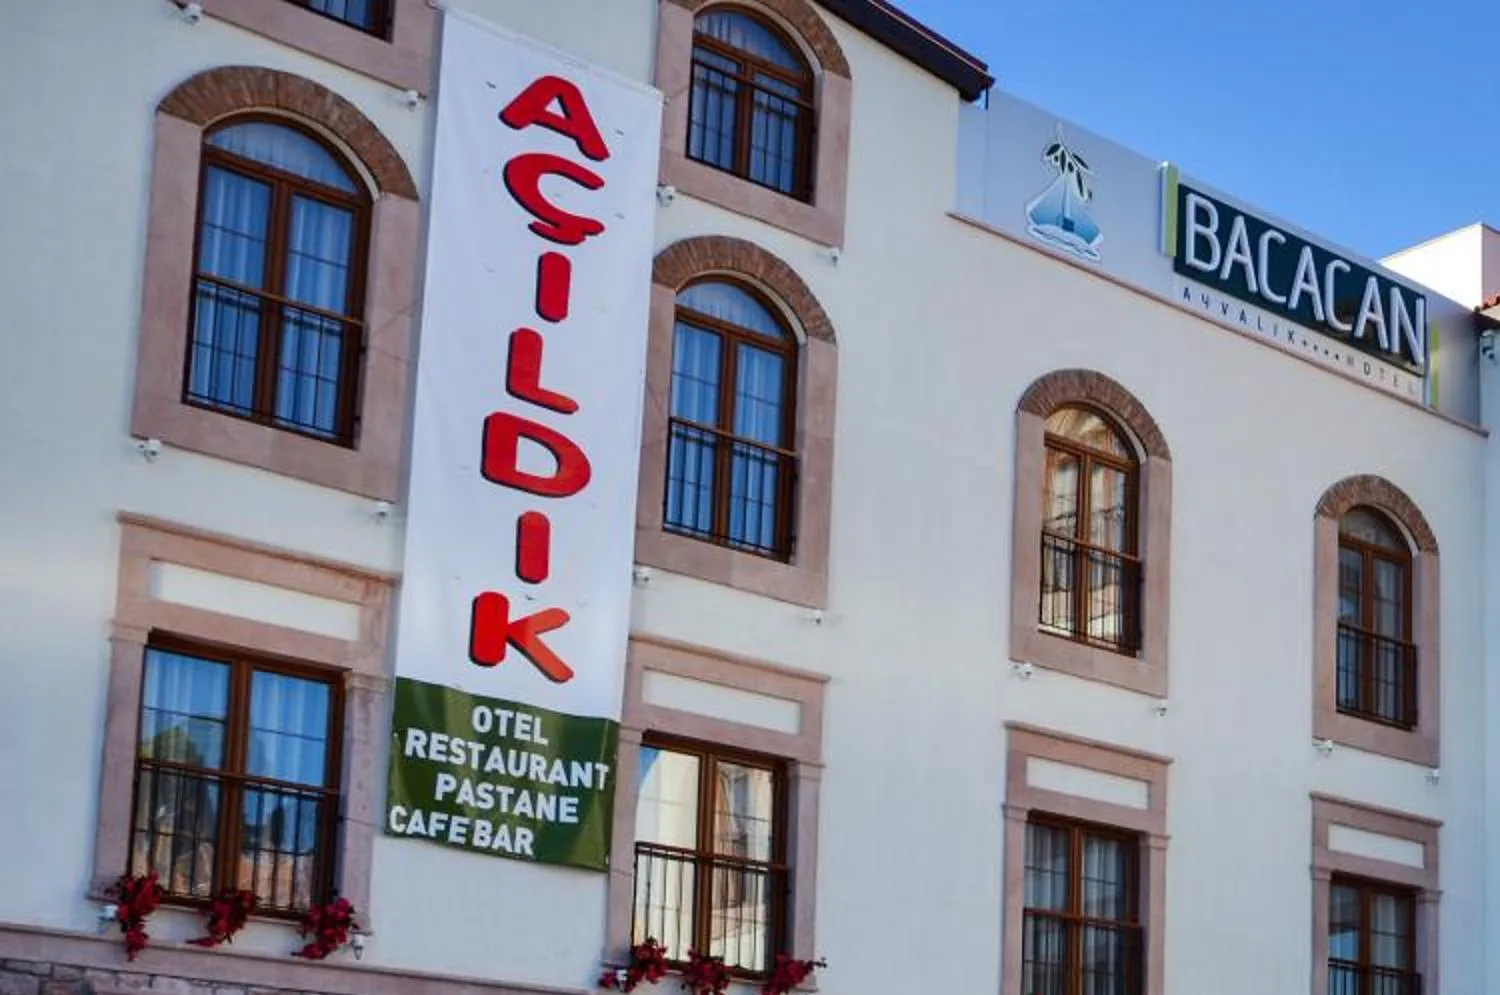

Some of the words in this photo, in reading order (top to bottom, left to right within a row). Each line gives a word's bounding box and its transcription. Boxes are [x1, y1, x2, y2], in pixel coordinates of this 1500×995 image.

[1185, 192, 1426, 367] BACACAN
[469, 75, 611, 684] AÇILDIK
[1346, 355, 1418, 395] HOTEL
[471, 705, 549, 746] OTEL
[405, 727, 609, 791] RESTAURANT
[434, 772, 579, 824] PASTANE
